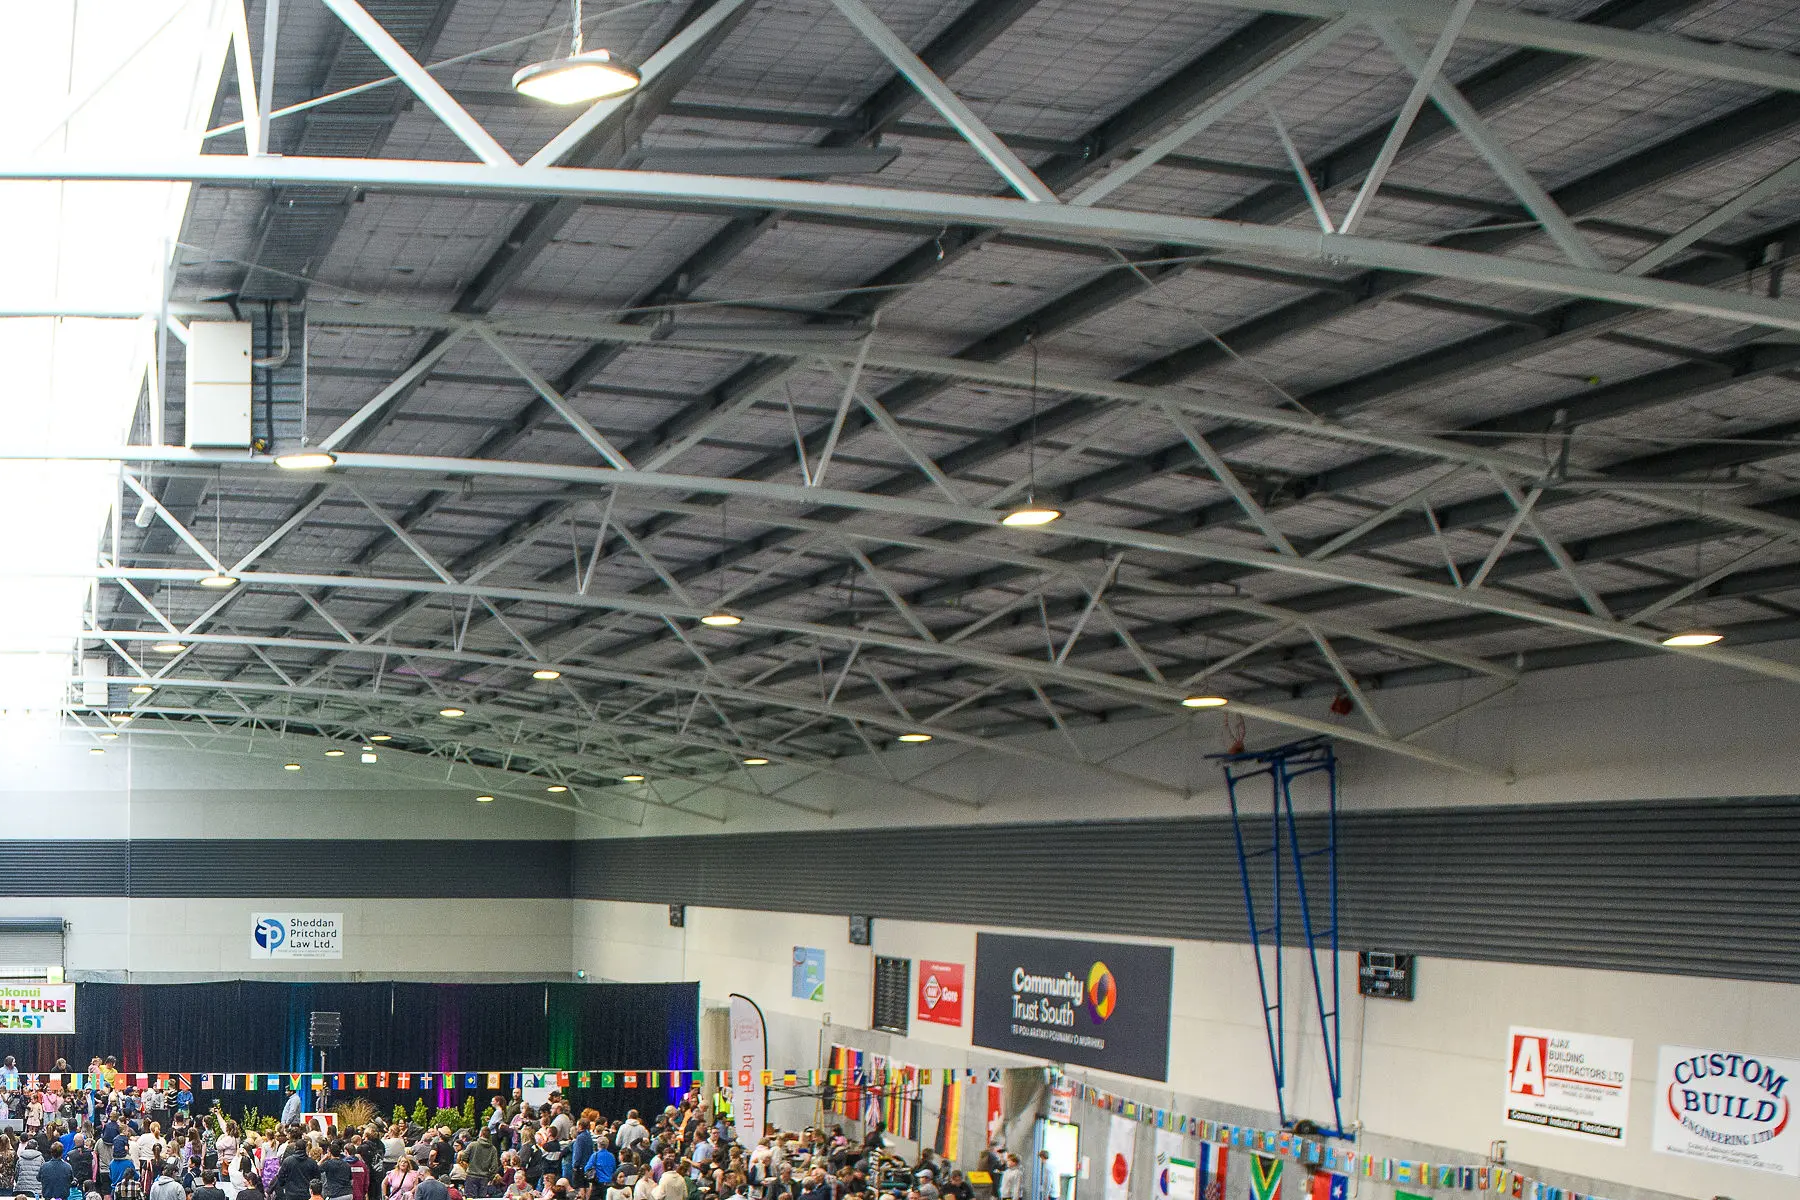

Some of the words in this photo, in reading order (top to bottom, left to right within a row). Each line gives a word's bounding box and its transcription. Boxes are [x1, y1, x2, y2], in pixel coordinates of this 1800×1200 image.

[290, 918, 334, 927] Sheddan
[290, 929, 337, 938] Pritchard
[290, 940, 310, 948] Law
[314, 940, 334, 948] Ltd.
[941, 986, 959, 1003] Gore
[1011, 966, 1084, 1006] Community
[1011, 994, 1039, 1021] Trust
[1040, 997, 1075, 1026] South
[1549, 1038, 1570, 1049] AJAX
[1549, 1050, 1585, 1063] BUILDING
[1548, 1063, 1607, 1081] CONTRACTORS
[1608, 1071, 1625, 1083] LTD
[1674, 1053, 1788, 1099] CUSTOM
[1682, 1089, 1777, 1122] BUILD
[1512, 1110, 1547, 1125] Commercial
[1681, 1116, 1750, 1146] ENGINEERING
[1751, 1129, 1774, 1145] LTD
